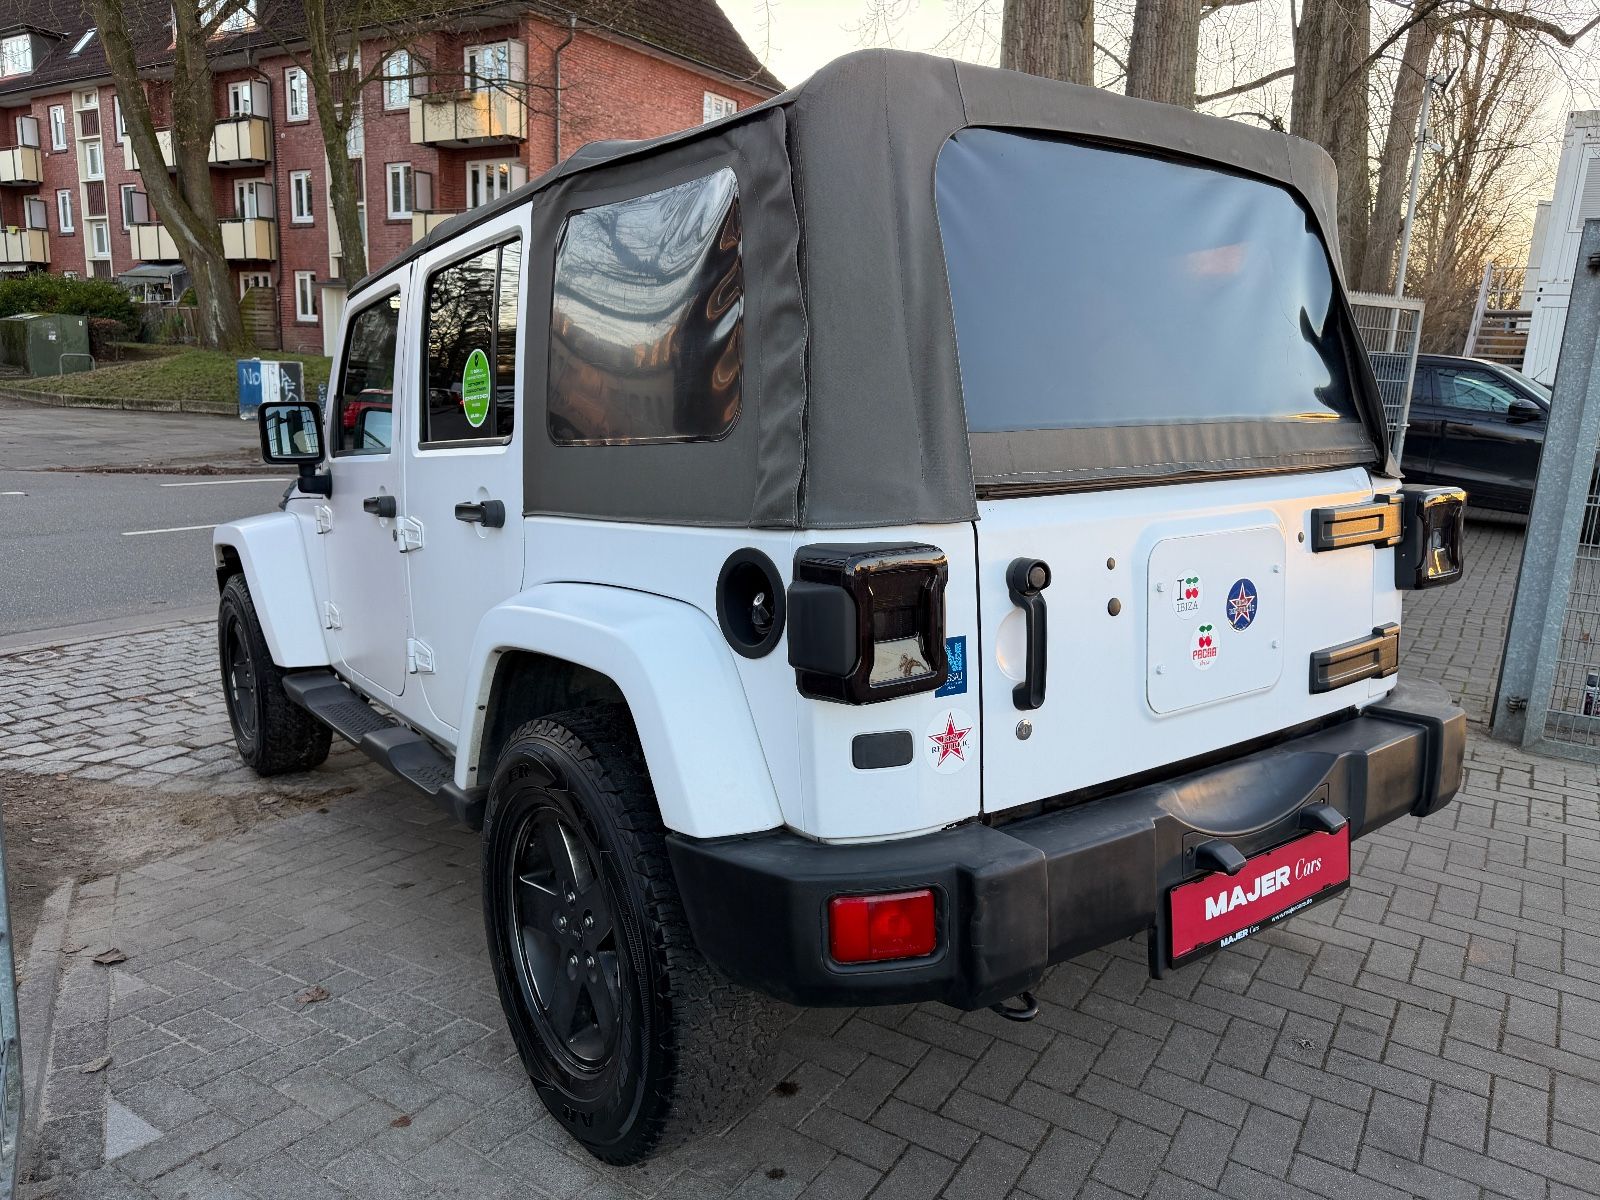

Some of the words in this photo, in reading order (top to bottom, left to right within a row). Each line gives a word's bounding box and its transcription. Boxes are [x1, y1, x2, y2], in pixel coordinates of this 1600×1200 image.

[243, 368, 260, 386] No
[1177, 579, 1185, 601] I
[1176, 601, 1199, 613] IBIZA
[1204, 865, 1291, 921] MAJER
[1295, 857, 1322, 880] Cars
[1220, 928, 1249, 948] MAJER
